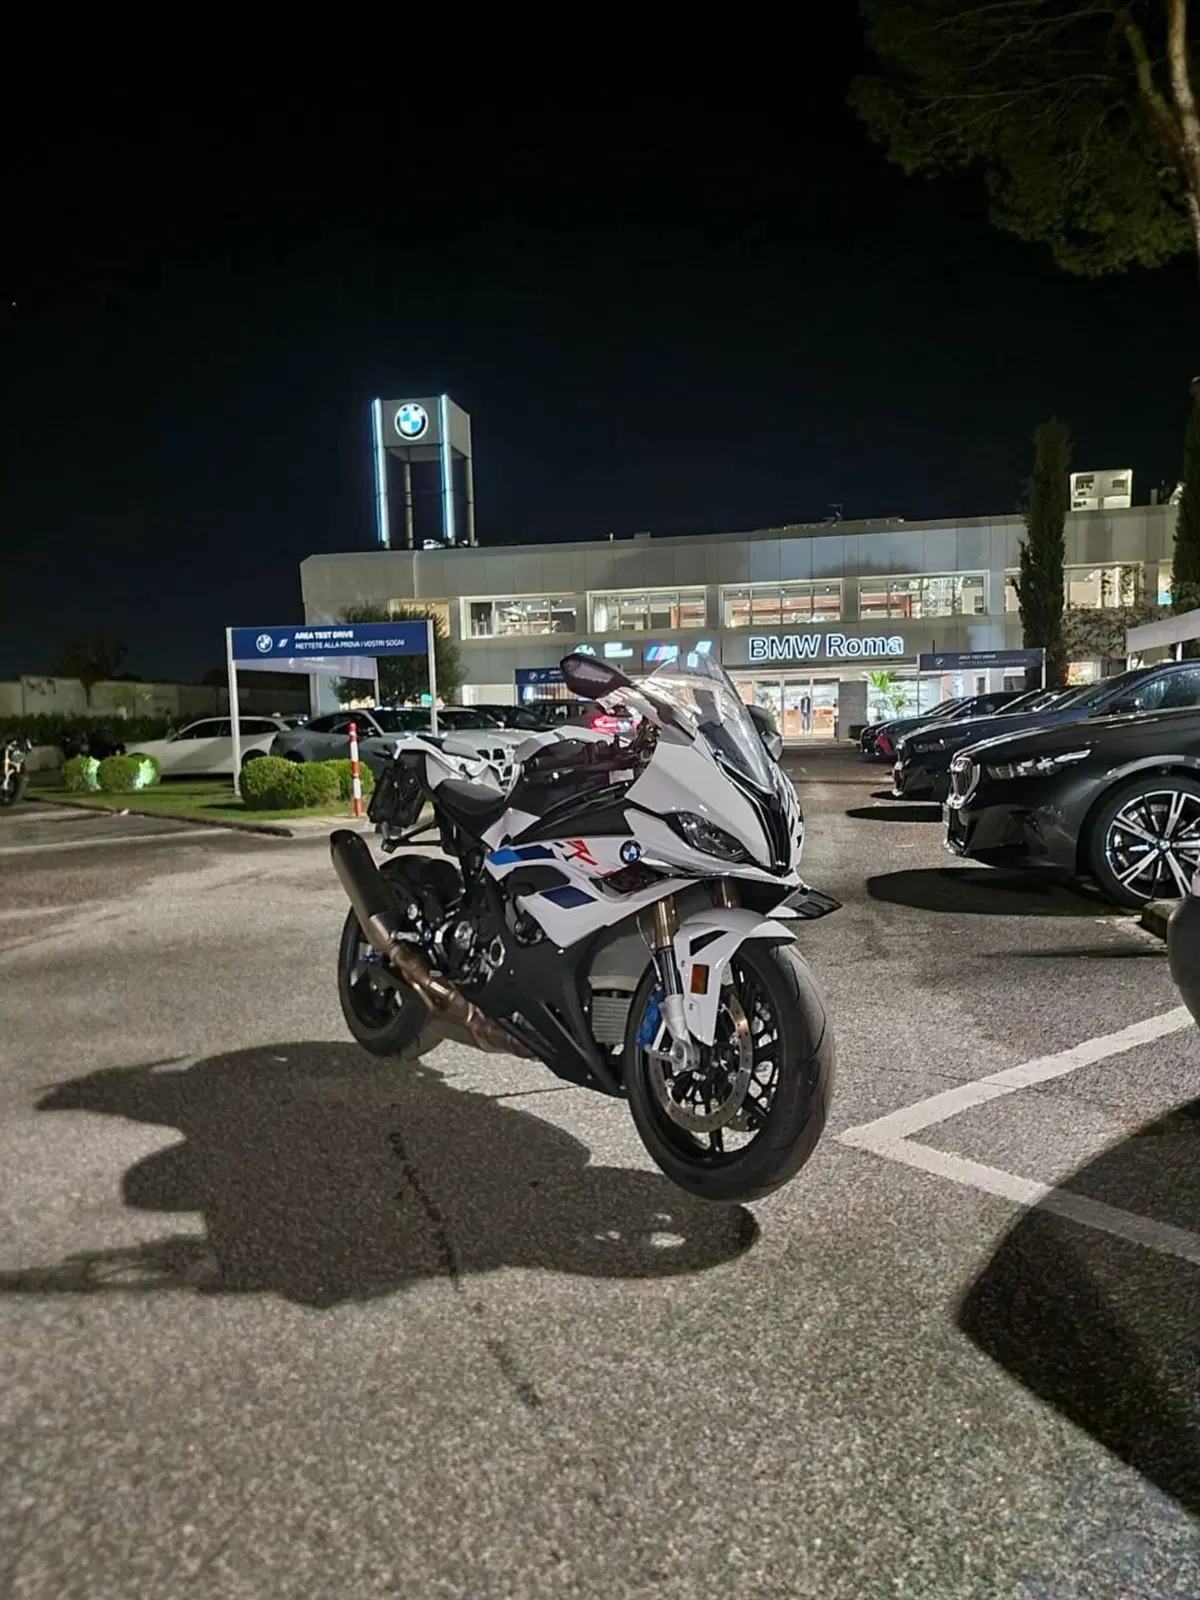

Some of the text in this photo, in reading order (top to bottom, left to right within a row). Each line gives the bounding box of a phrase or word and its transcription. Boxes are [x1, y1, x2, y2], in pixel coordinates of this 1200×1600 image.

[294, 630, 354, 640] AREA TEST DRIVE
[294, 641, 323, 650] METTETE
[323, 640, 340, 649] ALLA
[340, 640, 361, 648] PROVA
[363, 639, 385, 648] VOSTRI
[385, 638, 405, 647] SOGNI
[749, 633, 904, 660] BMW Roma
